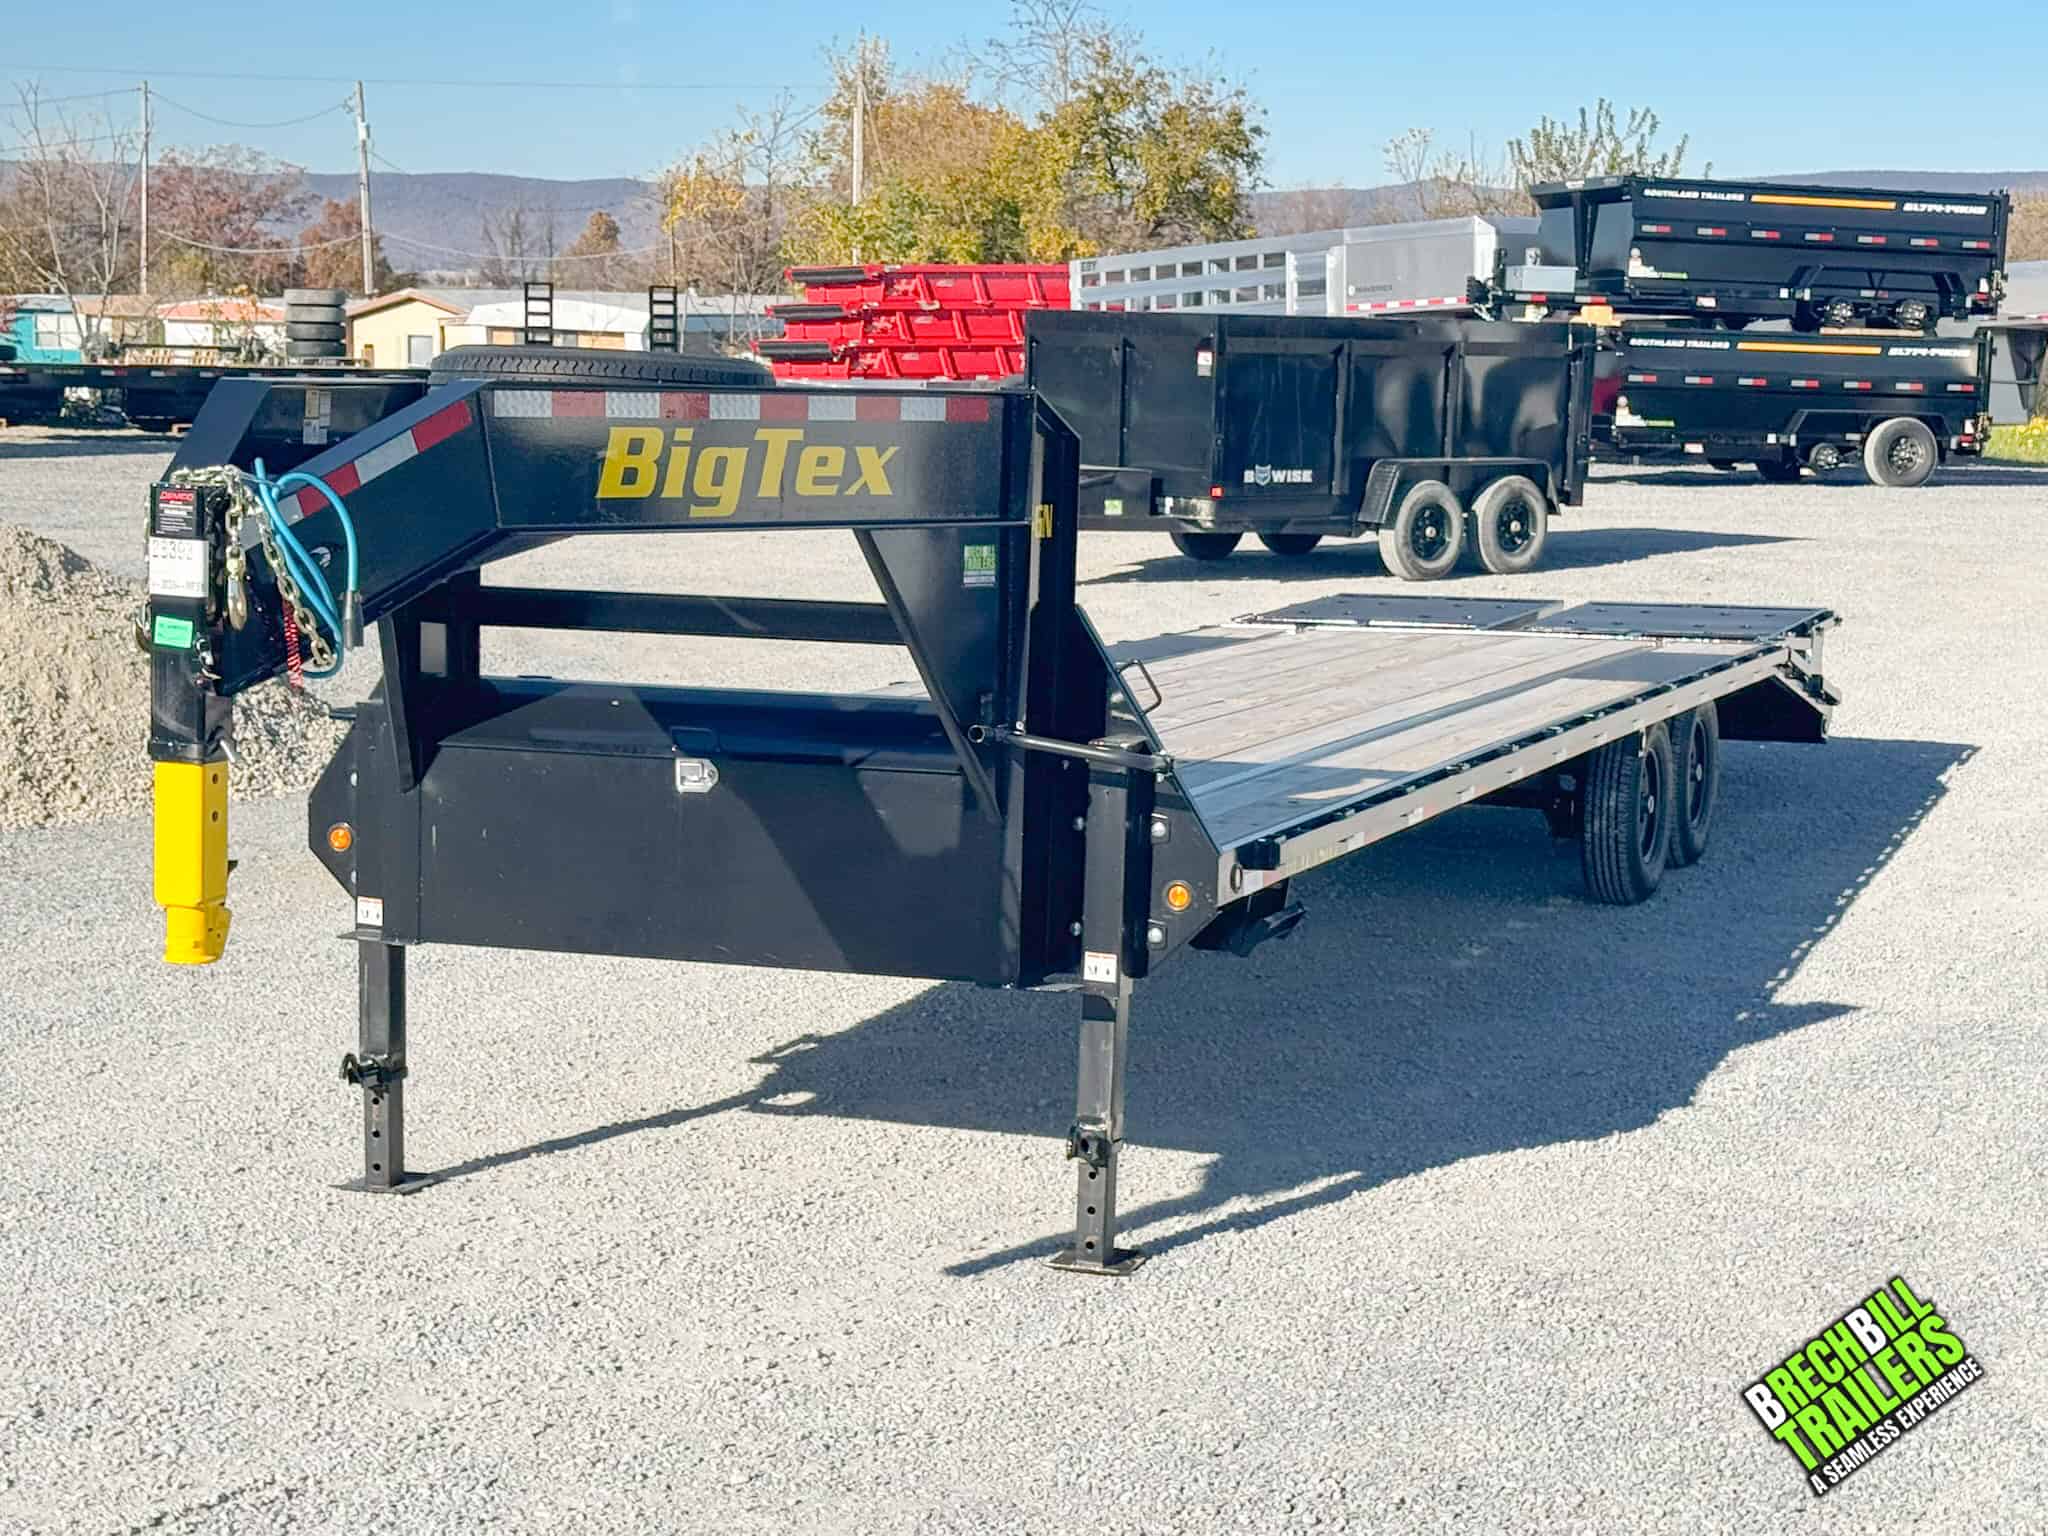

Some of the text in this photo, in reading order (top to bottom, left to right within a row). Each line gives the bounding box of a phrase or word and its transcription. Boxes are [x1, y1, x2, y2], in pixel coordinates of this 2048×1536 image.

[1700, 191, 1745, 202] TRAILERS
[1686, 340, 1731, 350] TRAILERS
[594, 426, 899, 518] BigTex
